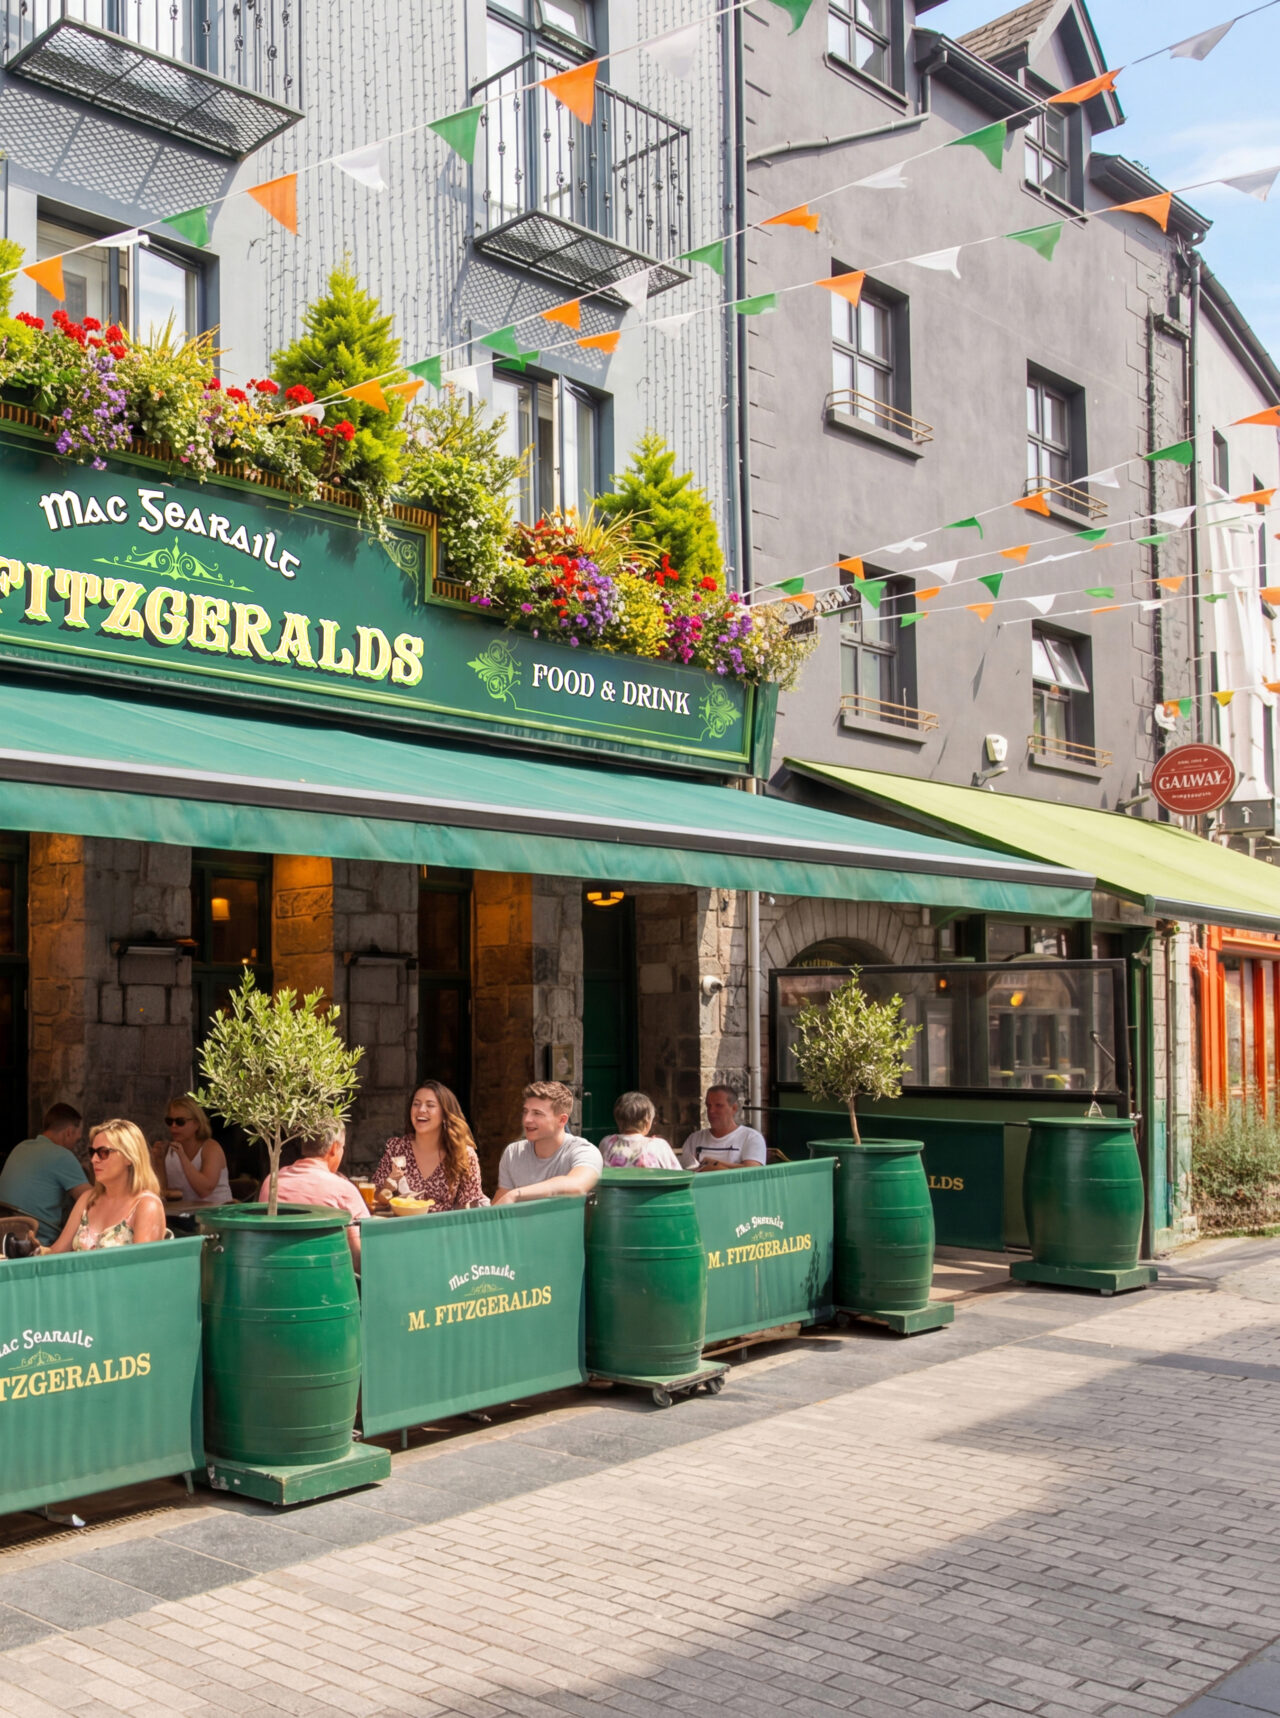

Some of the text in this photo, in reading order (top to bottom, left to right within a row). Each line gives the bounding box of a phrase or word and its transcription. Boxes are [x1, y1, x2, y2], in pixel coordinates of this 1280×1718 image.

[532, 663, 691, 715] FOOD & DRINK
[1159, 769, 1225, 790] GALWAY
[707, 1233, 812, 1269] M. FITZGERALDS
[408, 1285, 552, 1331] M. FITZGERALDS
